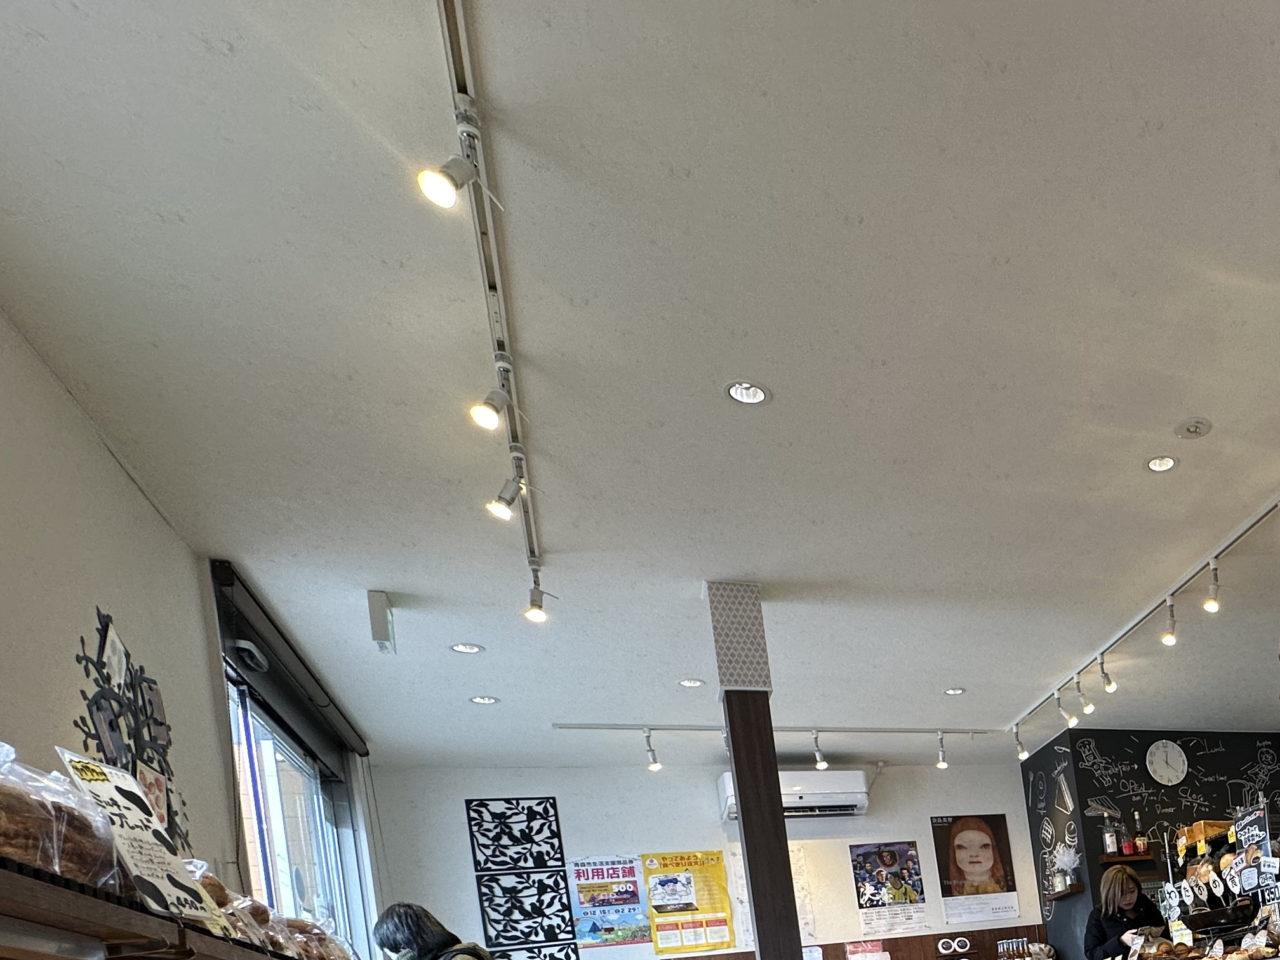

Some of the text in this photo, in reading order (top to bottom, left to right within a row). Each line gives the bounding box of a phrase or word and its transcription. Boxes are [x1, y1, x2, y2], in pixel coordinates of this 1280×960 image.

[574, 866, 636, 882] 利用店舗
[612, 884, 634, 893] 500
